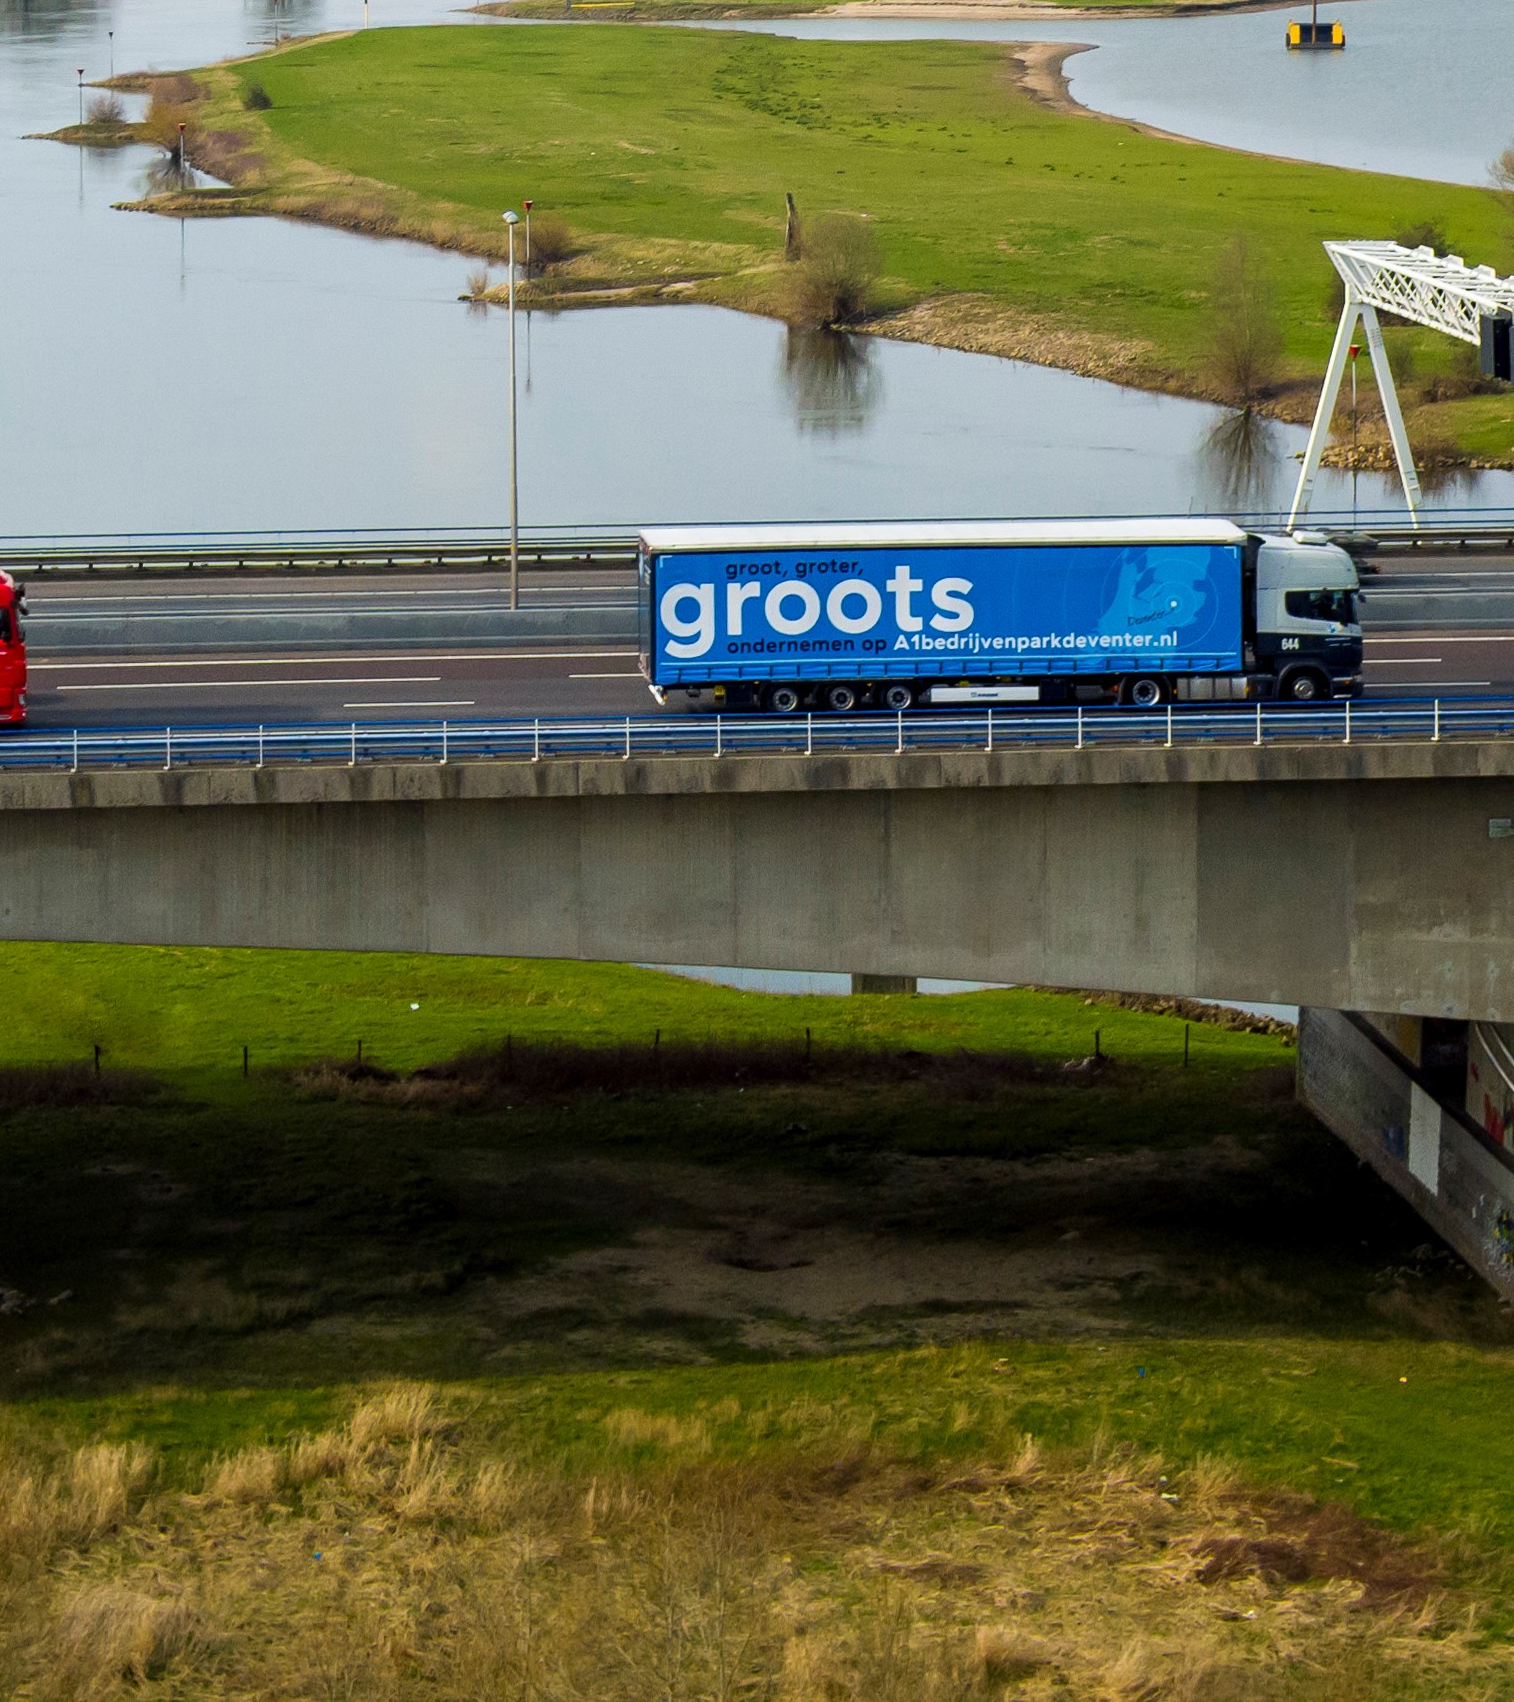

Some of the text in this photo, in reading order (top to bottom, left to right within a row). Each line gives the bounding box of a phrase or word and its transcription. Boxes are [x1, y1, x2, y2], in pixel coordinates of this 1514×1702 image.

[725, 559, 863, 580] groot, groter,
[660, 565, 974, 659] groots
[727, 631, 1178, 655] ondernemen op A1bedrijvenparkdeventer.nl
[1281, 637, 1300, 650] 644
